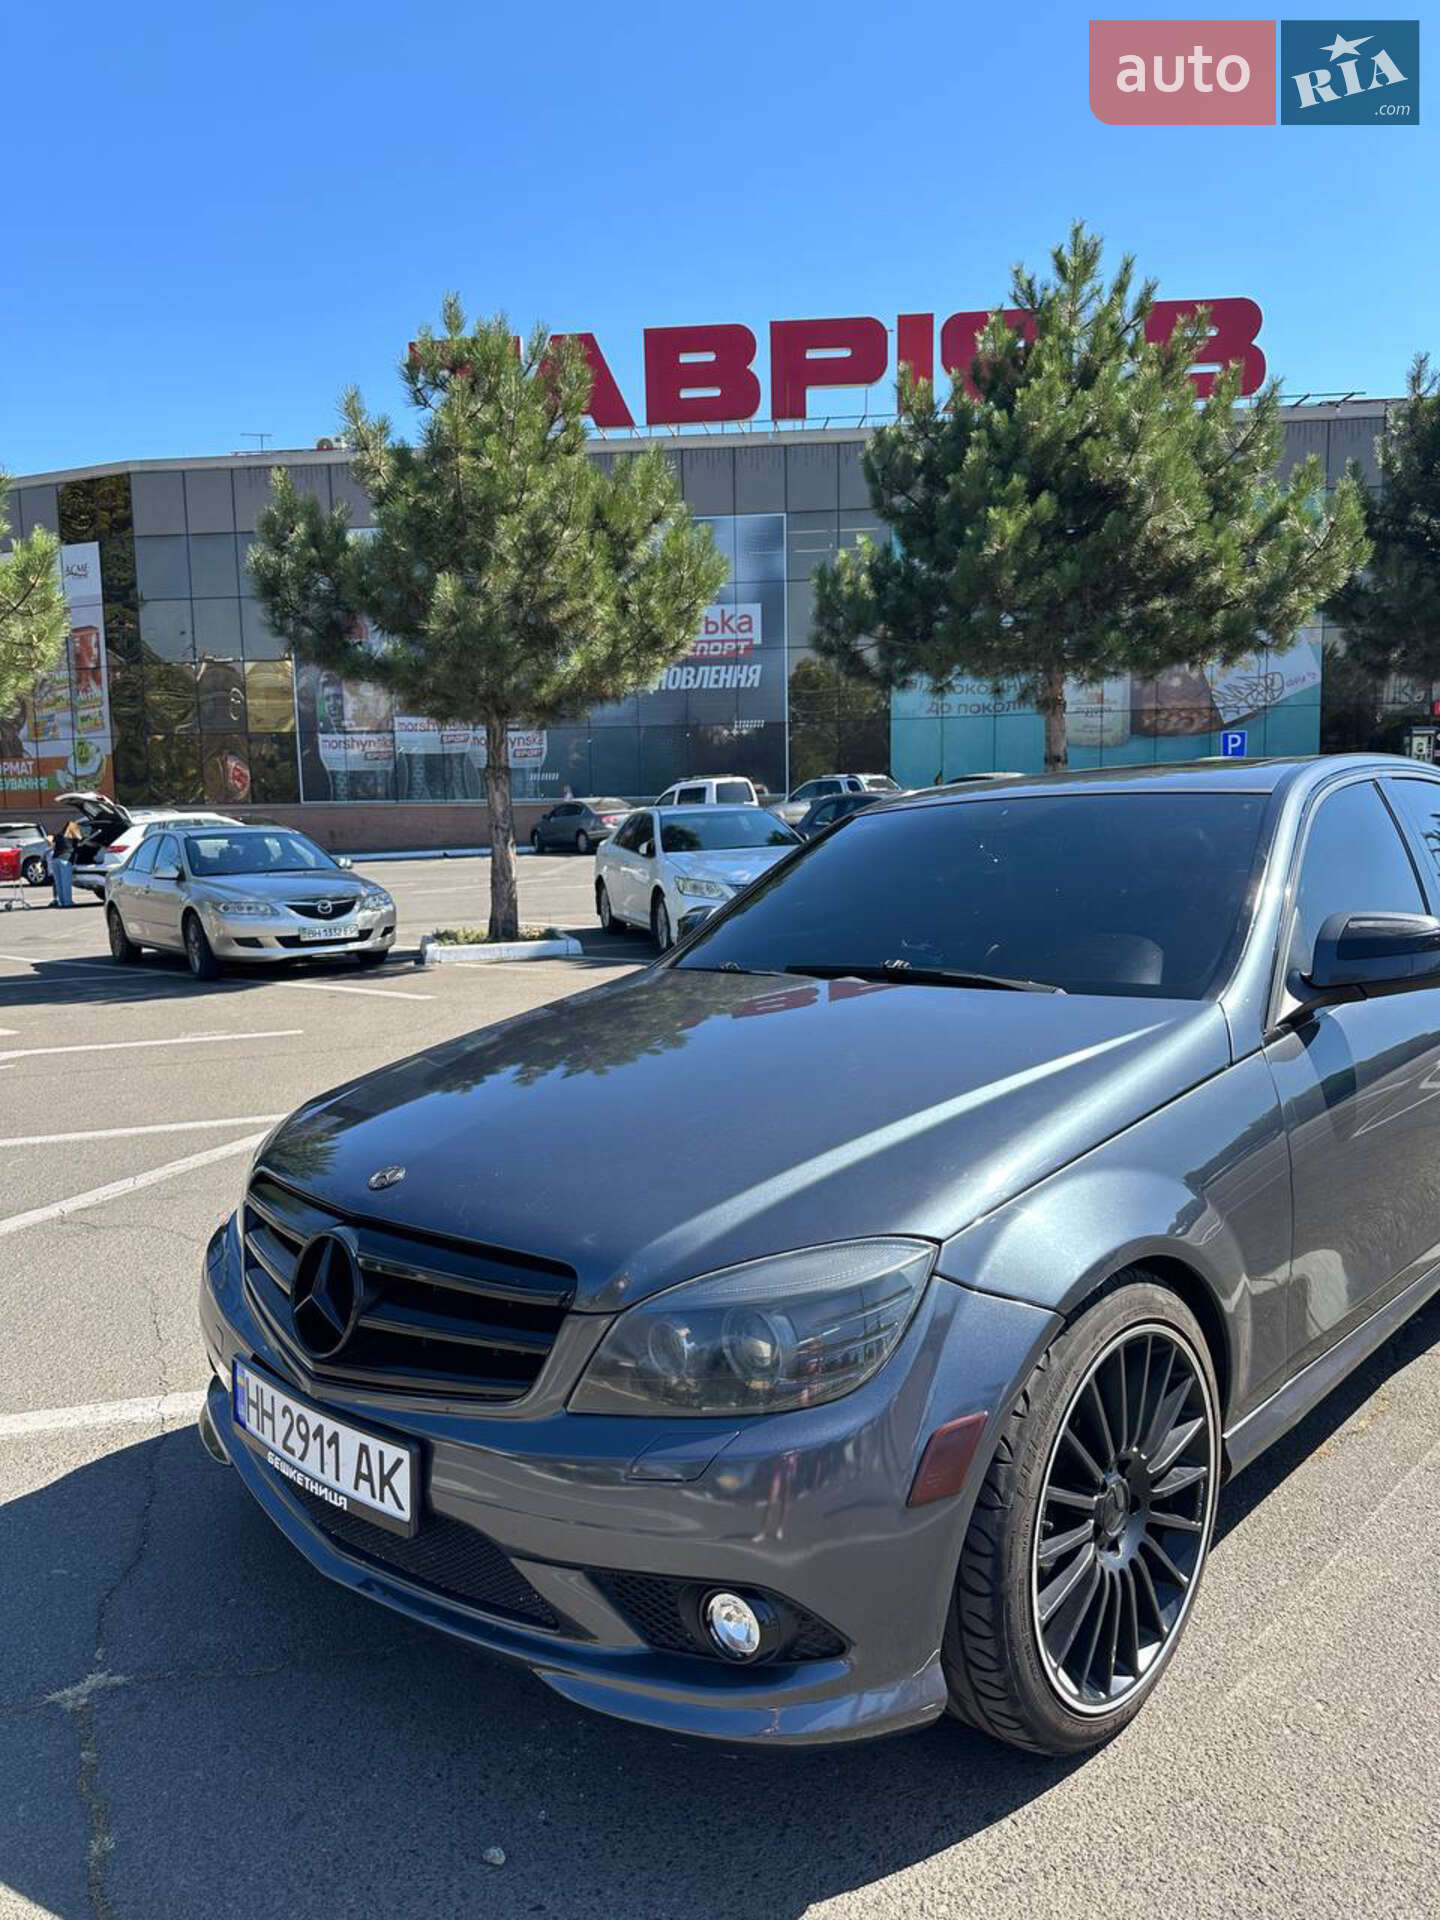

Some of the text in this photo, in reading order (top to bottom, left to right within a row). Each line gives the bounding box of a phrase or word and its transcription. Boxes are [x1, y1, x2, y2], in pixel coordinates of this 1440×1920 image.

[408, 297, 1265, 428] АВРІ В
[698, 608, 754, 634] ька
[1227, 734, 1242, 754] P
[245, 1376, 406, 1512] HH 2911 AK
[266, 1450, 348, 1511] БЕШКЕТНИЦЯ
